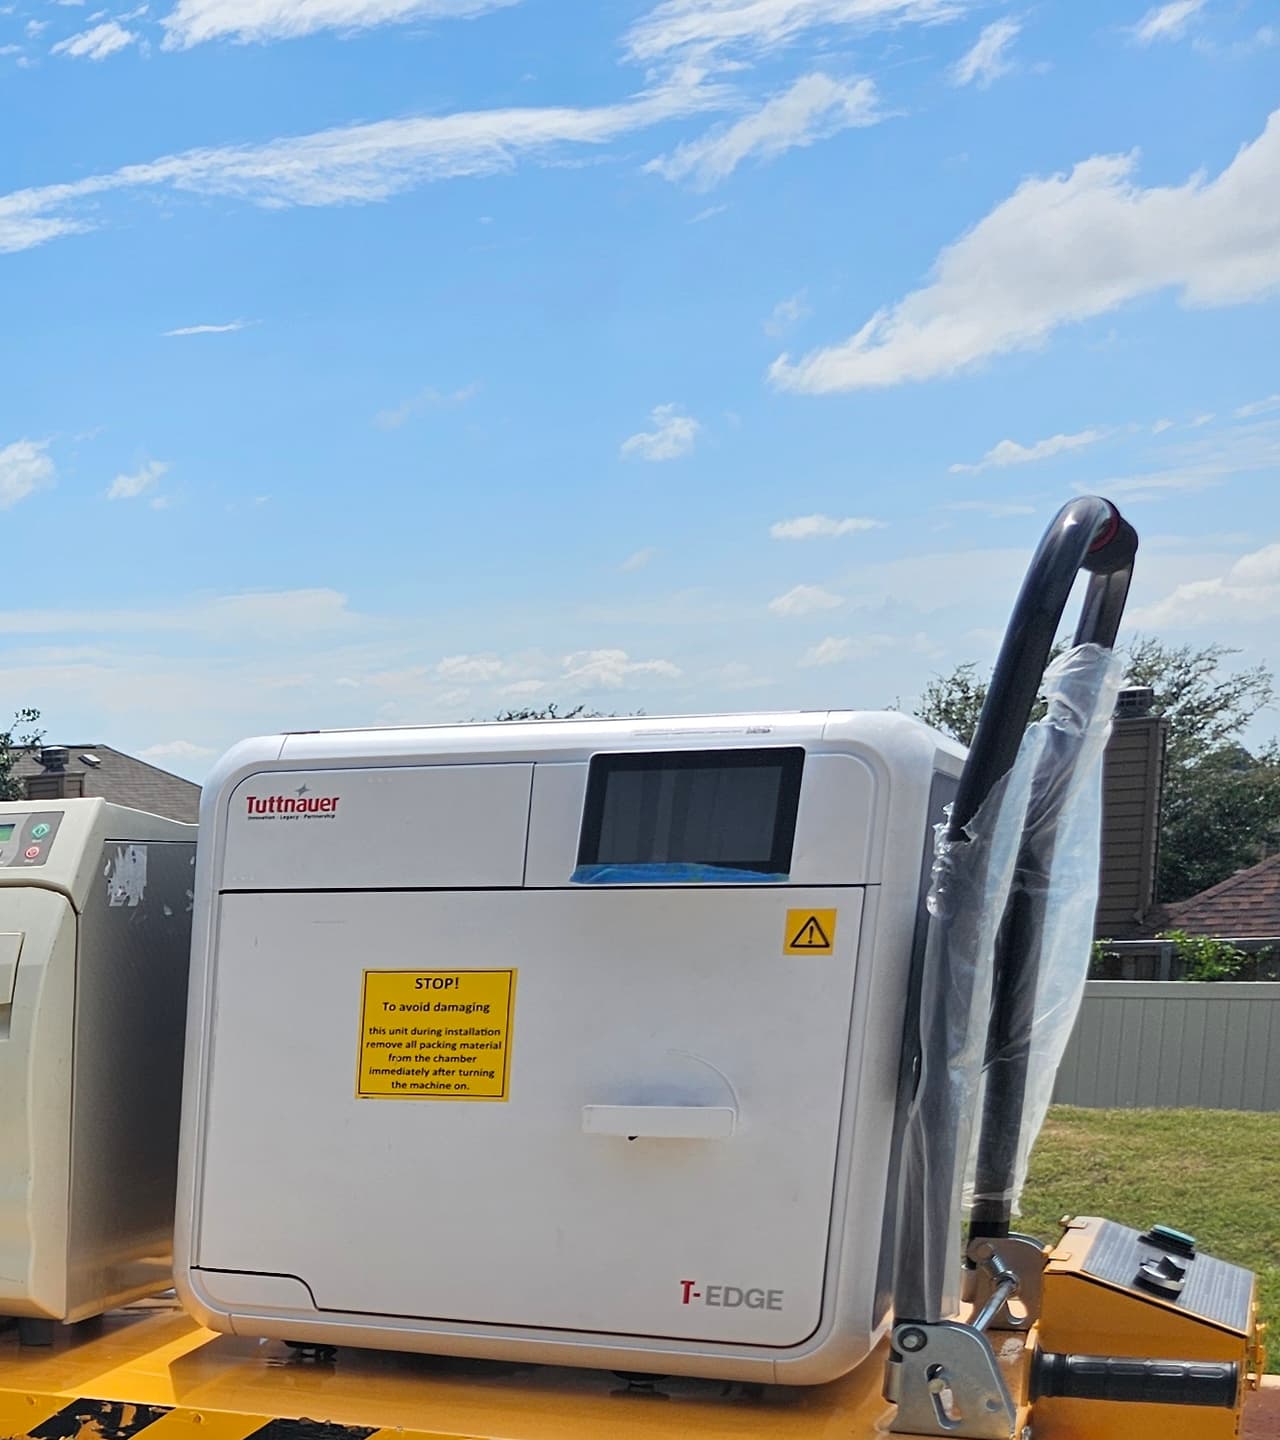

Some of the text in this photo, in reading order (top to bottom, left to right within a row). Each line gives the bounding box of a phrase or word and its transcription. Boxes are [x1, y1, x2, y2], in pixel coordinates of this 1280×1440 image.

[246, 796, 340, 814] Tuttnauer
[415, 977, 460, 989] STOP!
[382, 1002, 491, 1014] To avoid damaging
[369, 1027, 501, 1037] this unit during installation
[366, 1040, 502, 1051] remove all packing material
[388, 1053, 477, 1063] from the chamber
[369, 1067, 495, 1078] immediately after turning
[391, 1080, 470, 1090] the machine on.
